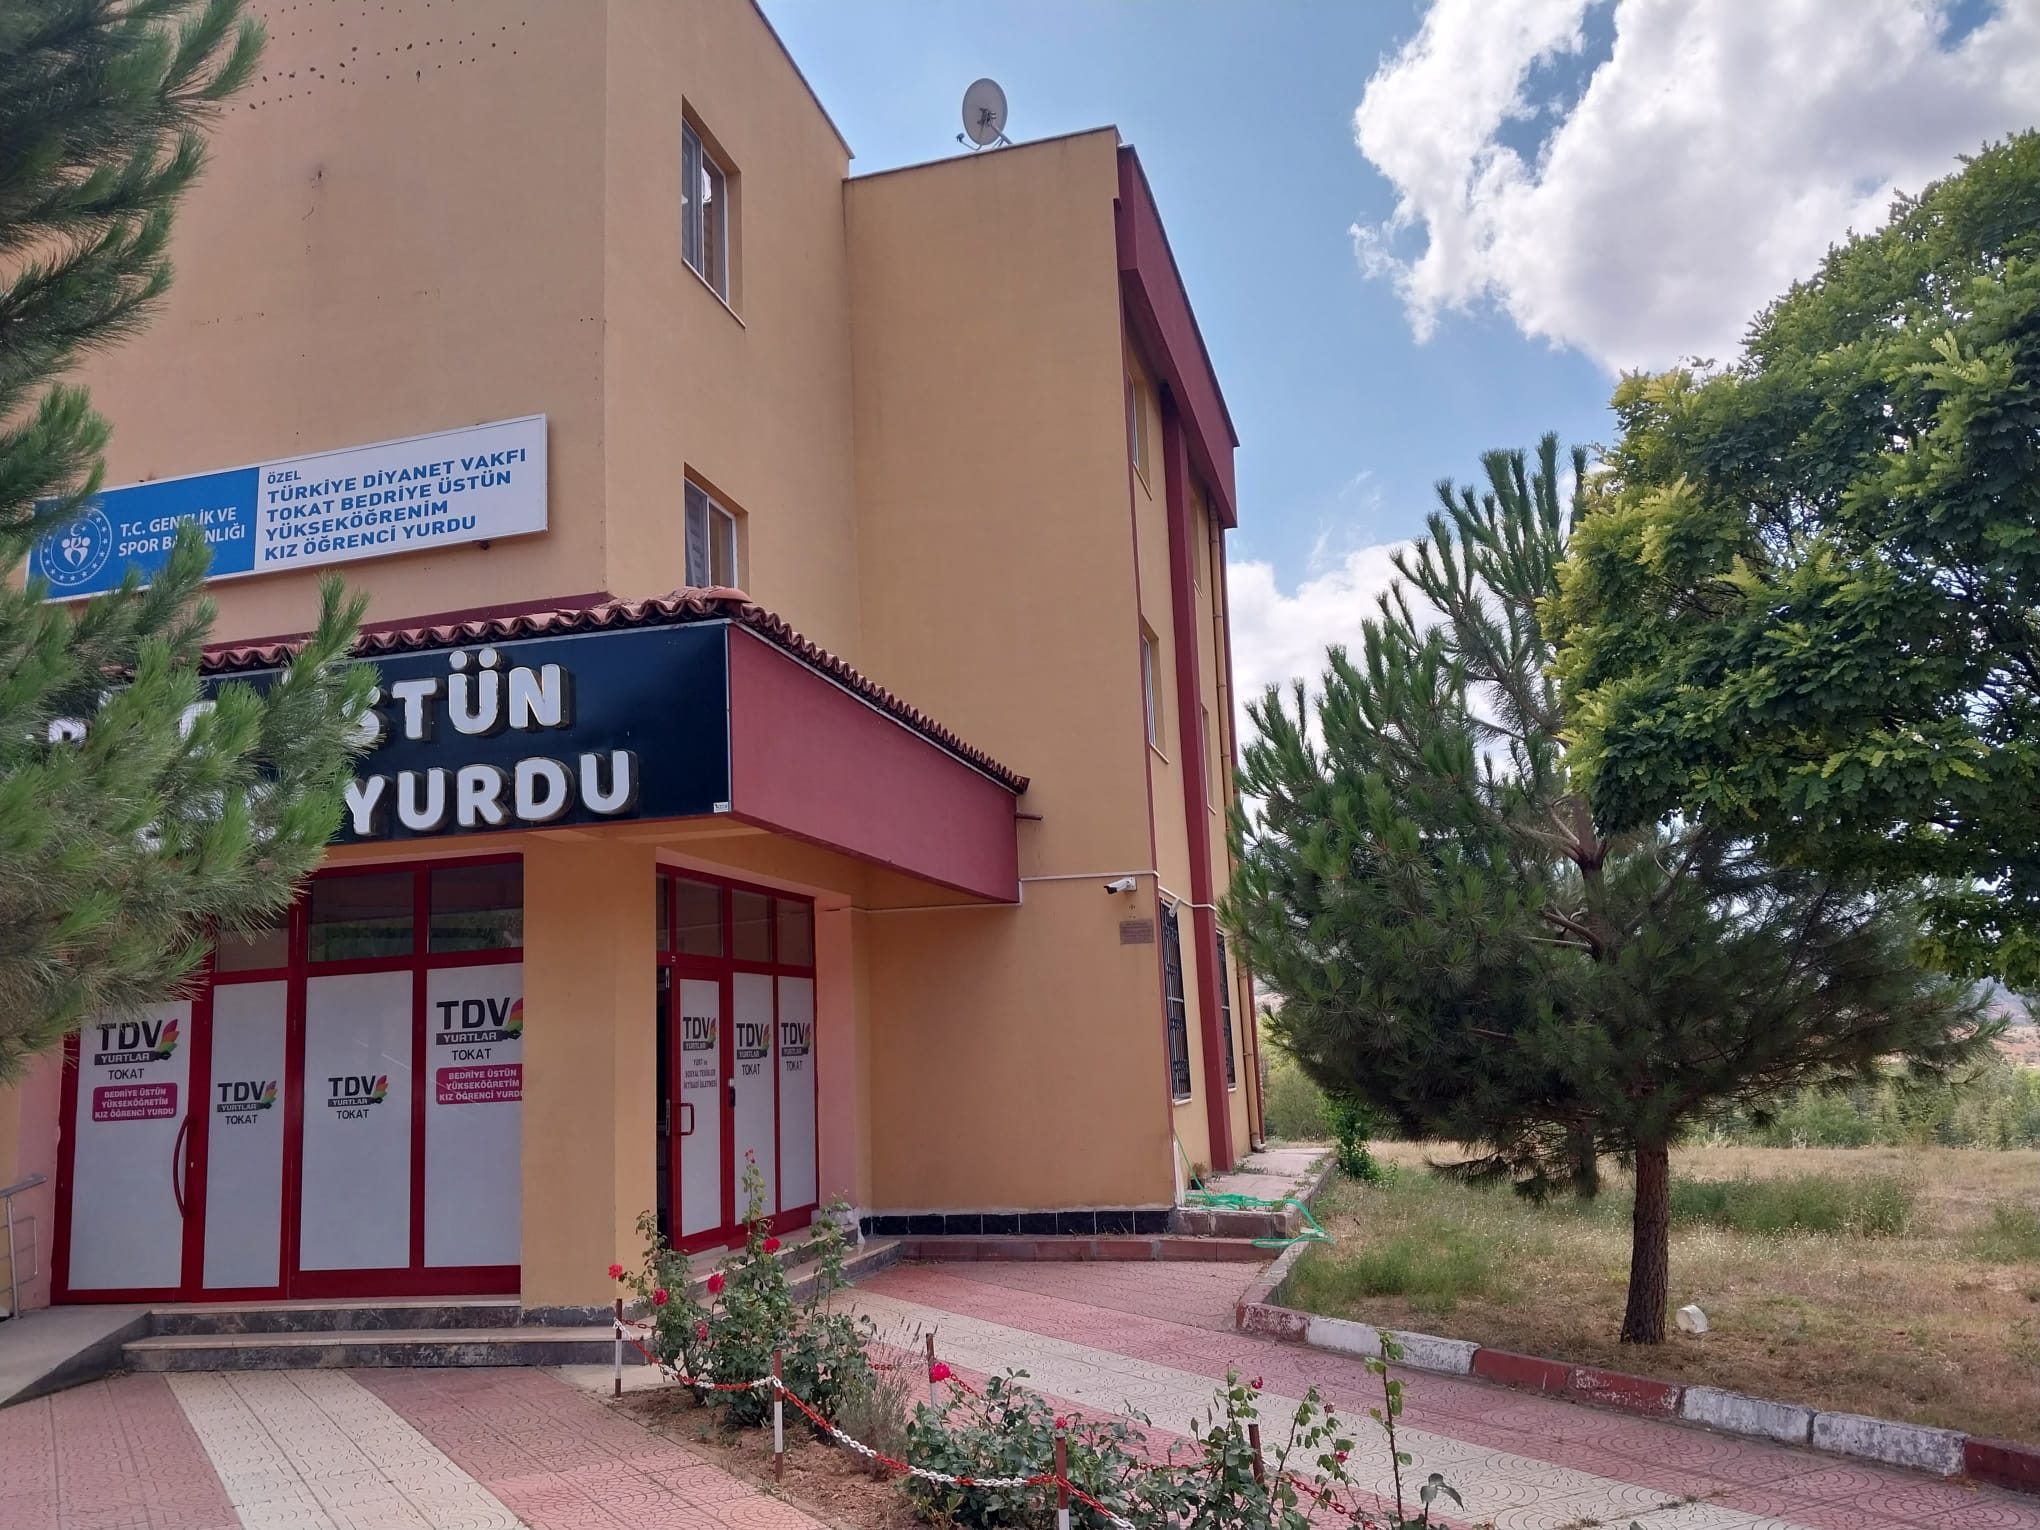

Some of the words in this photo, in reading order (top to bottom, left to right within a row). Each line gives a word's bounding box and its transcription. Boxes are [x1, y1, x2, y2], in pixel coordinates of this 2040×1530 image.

[267, 470, 301, 484] ÖZEL
[268, 477, 356, 503] TÜRKİYE
[364, 460, 454, 488] DİYANET
[461, 448, 526, 471] VAKFI
[267, 500, 335, 522] TOKAT
[341, 484, 431, 511] BEDRİYE
[438, 470, 511, 495] ÜSTÜN
[120, 522, 145, 537] T.C.
[217, 507, 237, 522] VE
[266, 500, 448, 541] YÜKSEKÖĞRENİM
[119, 539, 158, 557] SPOR
[265, 544, 298, 560] KIZ
[303, 527, 396, 555] ÖĞRENCİ
[403, 515, 476, 539] YURDU
[345, 750, 632, 835] YURDU
[436, 997, 510, 1030] TDV
[96, 1020, 162, 1051] TDV
[444, 1032, 497, 1043] YURTLAR
[683, 1017, 710, 1039] TDV
[736, 1023, 763, 1047] TDV
[781, 1022, 805, 1045] TDV
[101, 1053, 150, 1063] YURTLAR
[452, 1048, 492, 1061] TOKAT
[108, 1068, 144, 1080] TOKAT
[742, 1064, 760, 1075] TOKAT
[786, 1061, 803, 1072] TOKAT
[217, 1081, 266, 1102] TDV
[328, 1075, 376, 1096] TDV
[496, 1090, 523, 1098] YURD
[332, 1098, 368, 1106] YURTLAR
[225, 1114, 258, 1125] TOKAT
[336, 1109, 369, 1119] TOKAT
